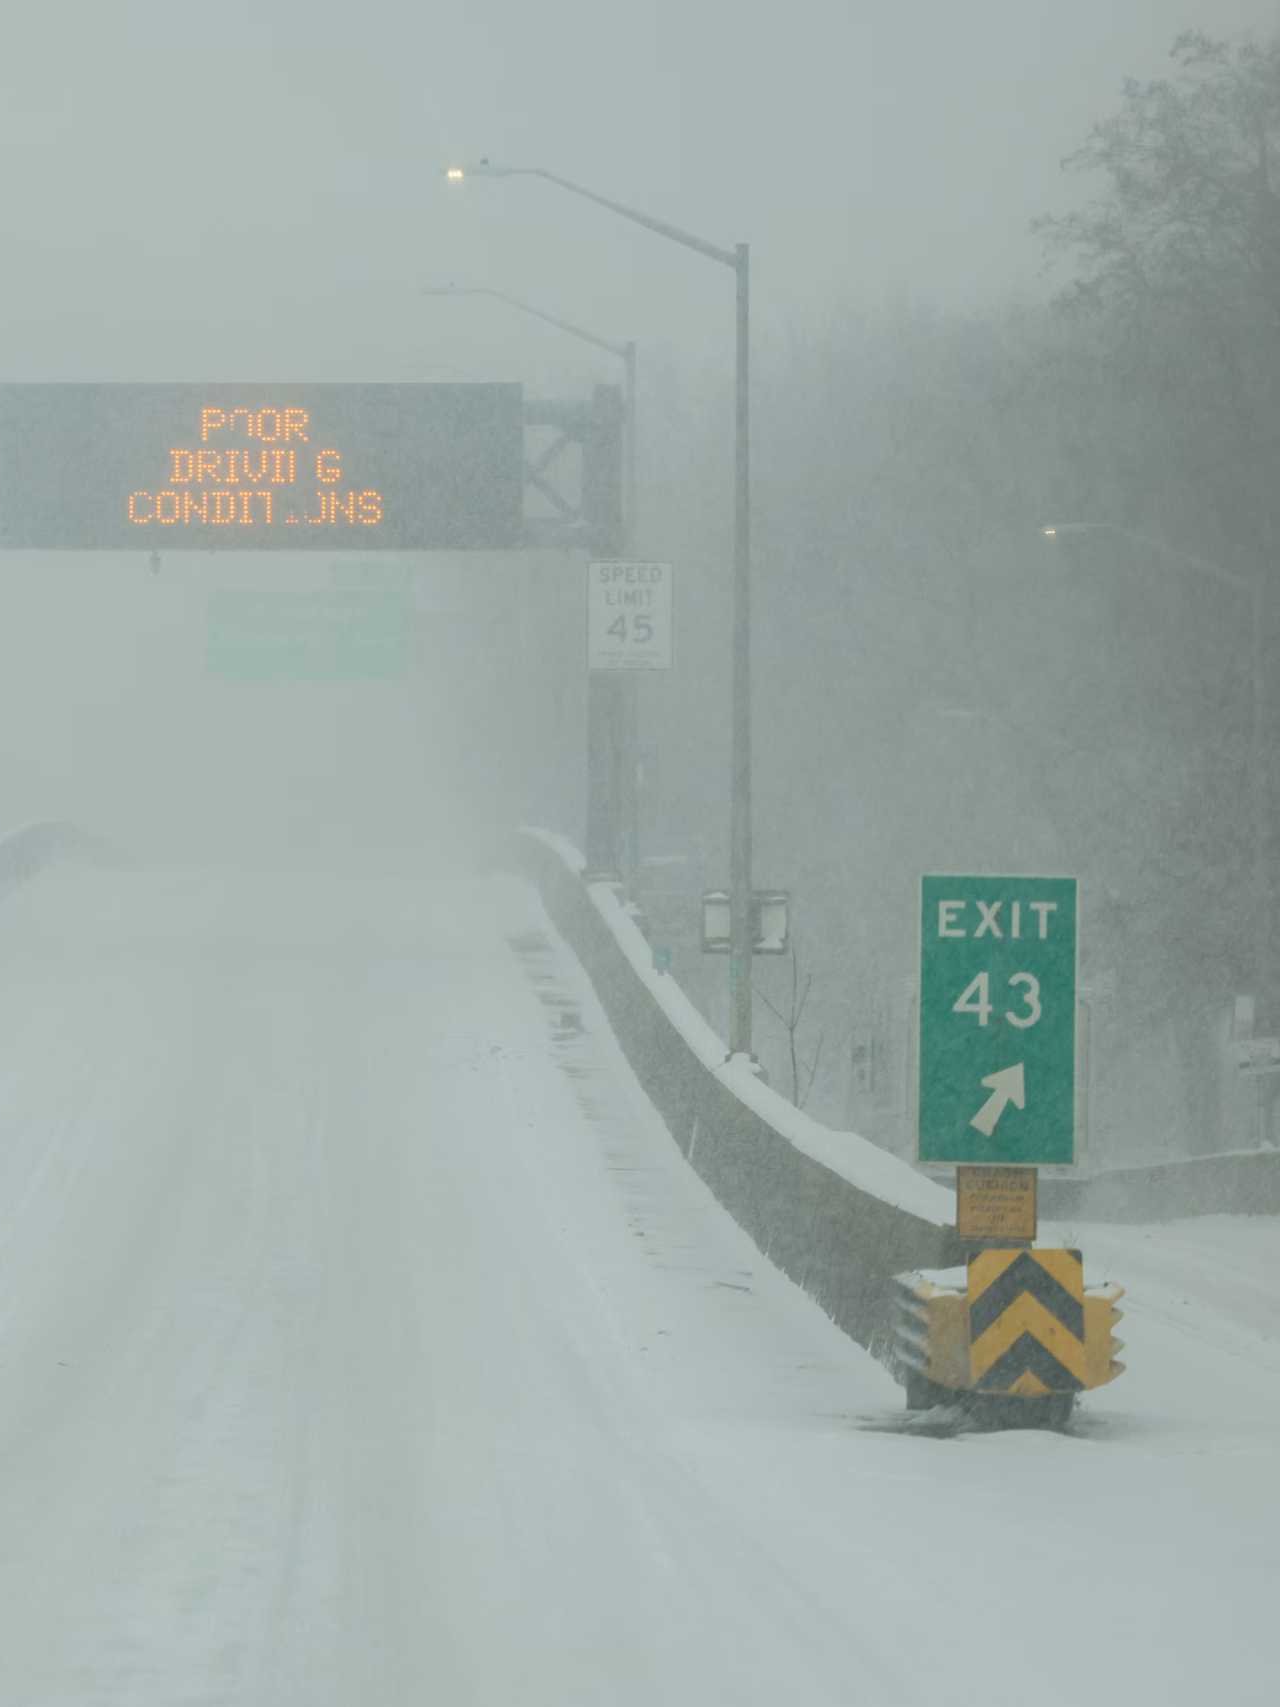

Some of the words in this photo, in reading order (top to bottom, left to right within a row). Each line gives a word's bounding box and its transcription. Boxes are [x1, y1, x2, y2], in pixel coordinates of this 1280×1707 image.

[202, 409, 308, 441] POOR
[599, 567, 662, 583] SPEED
[606, 589, 654, 606] LIMIT
[606, 613, 654, 644] 45
[937, 899, 1059, 939] EXIT
[952, 971, 1042, 1029] 43
